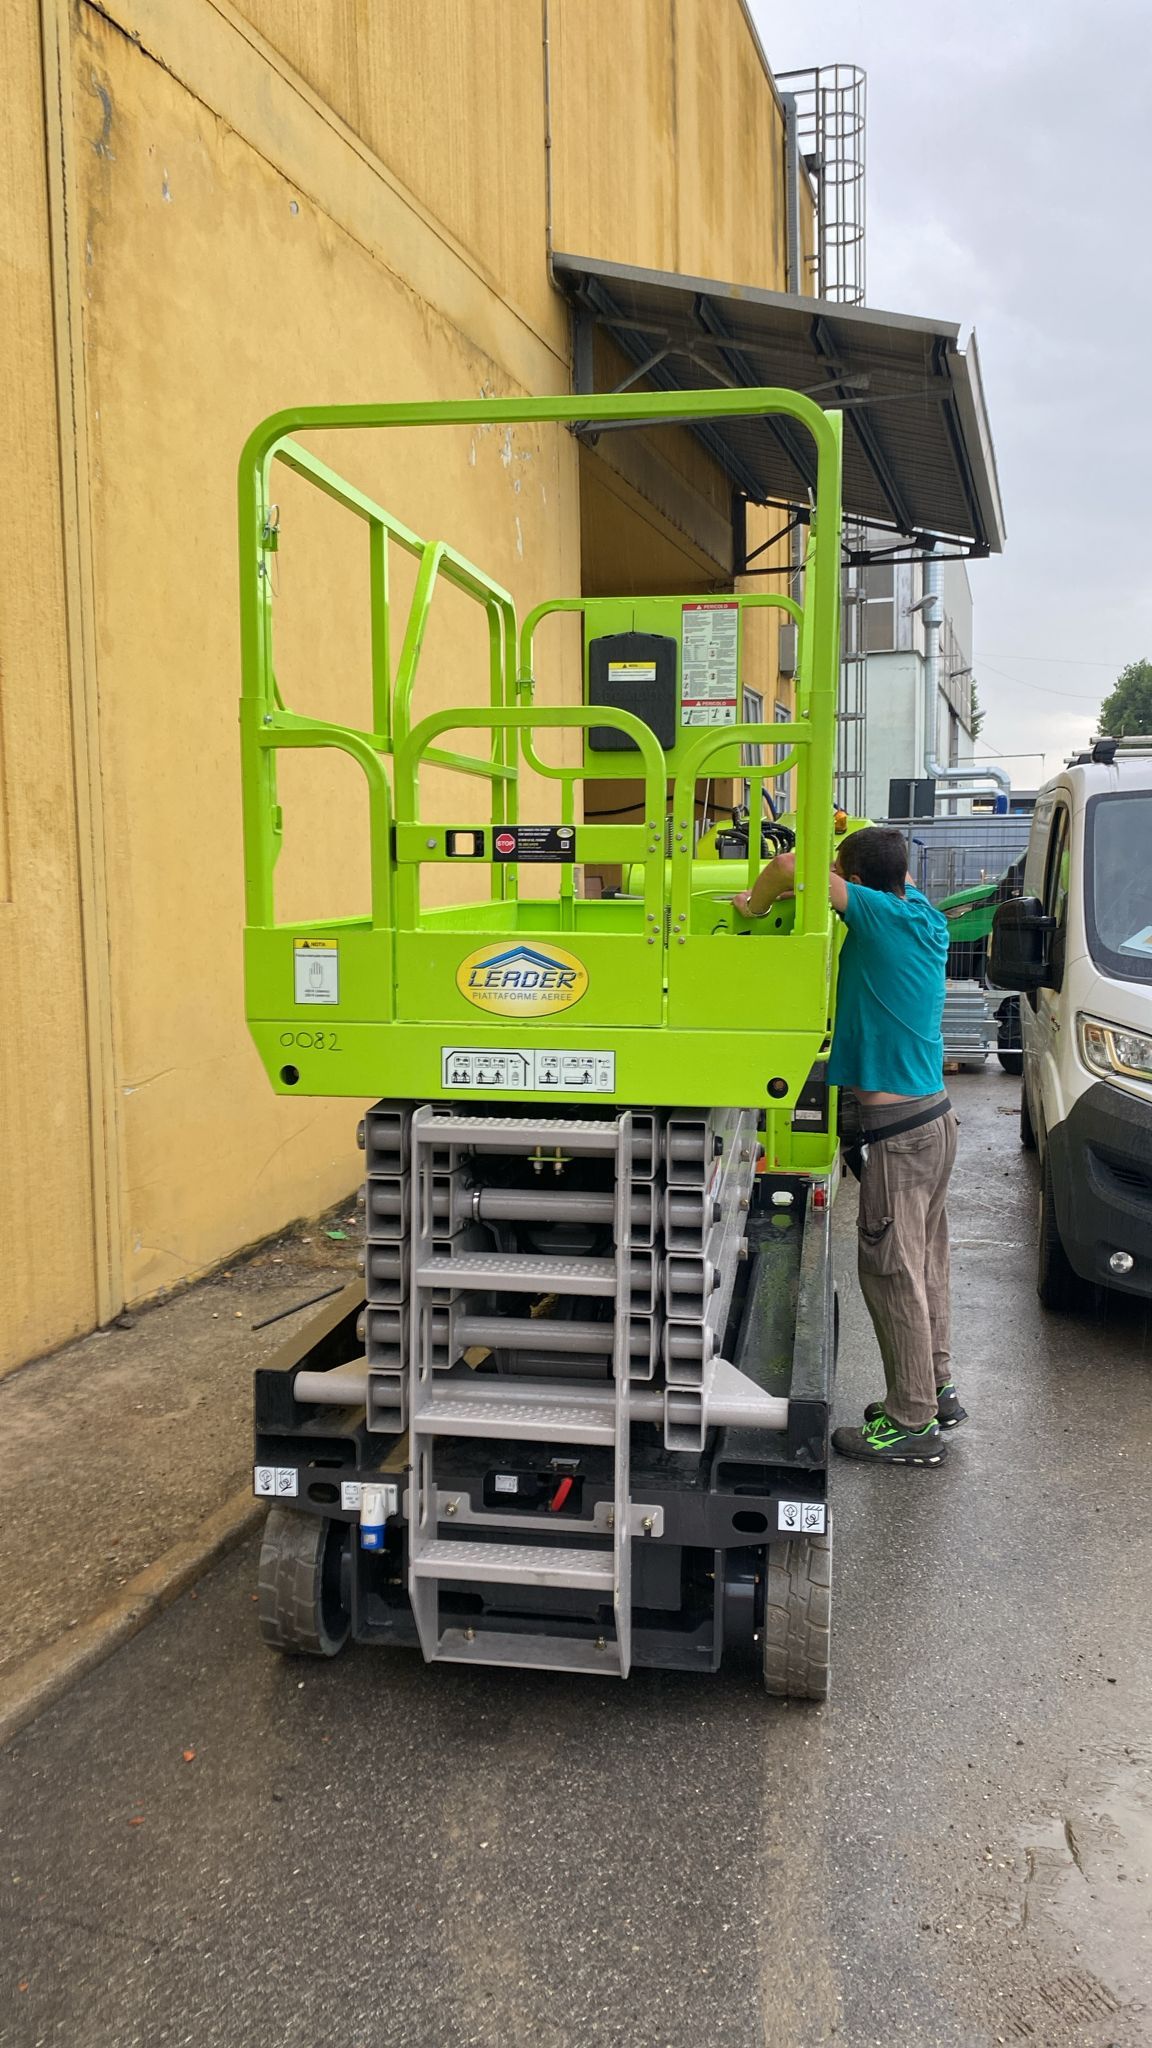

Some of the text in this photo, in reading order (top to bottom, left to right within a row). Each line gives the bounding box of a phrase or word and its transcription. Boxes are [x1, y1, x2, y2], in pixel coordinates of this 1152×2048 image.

[468, 970, 577, 989] LEADER
[472, 992, 573, 1001] PIATTAFORME AEREE
[279, 1031, 343, 1051] 0082
